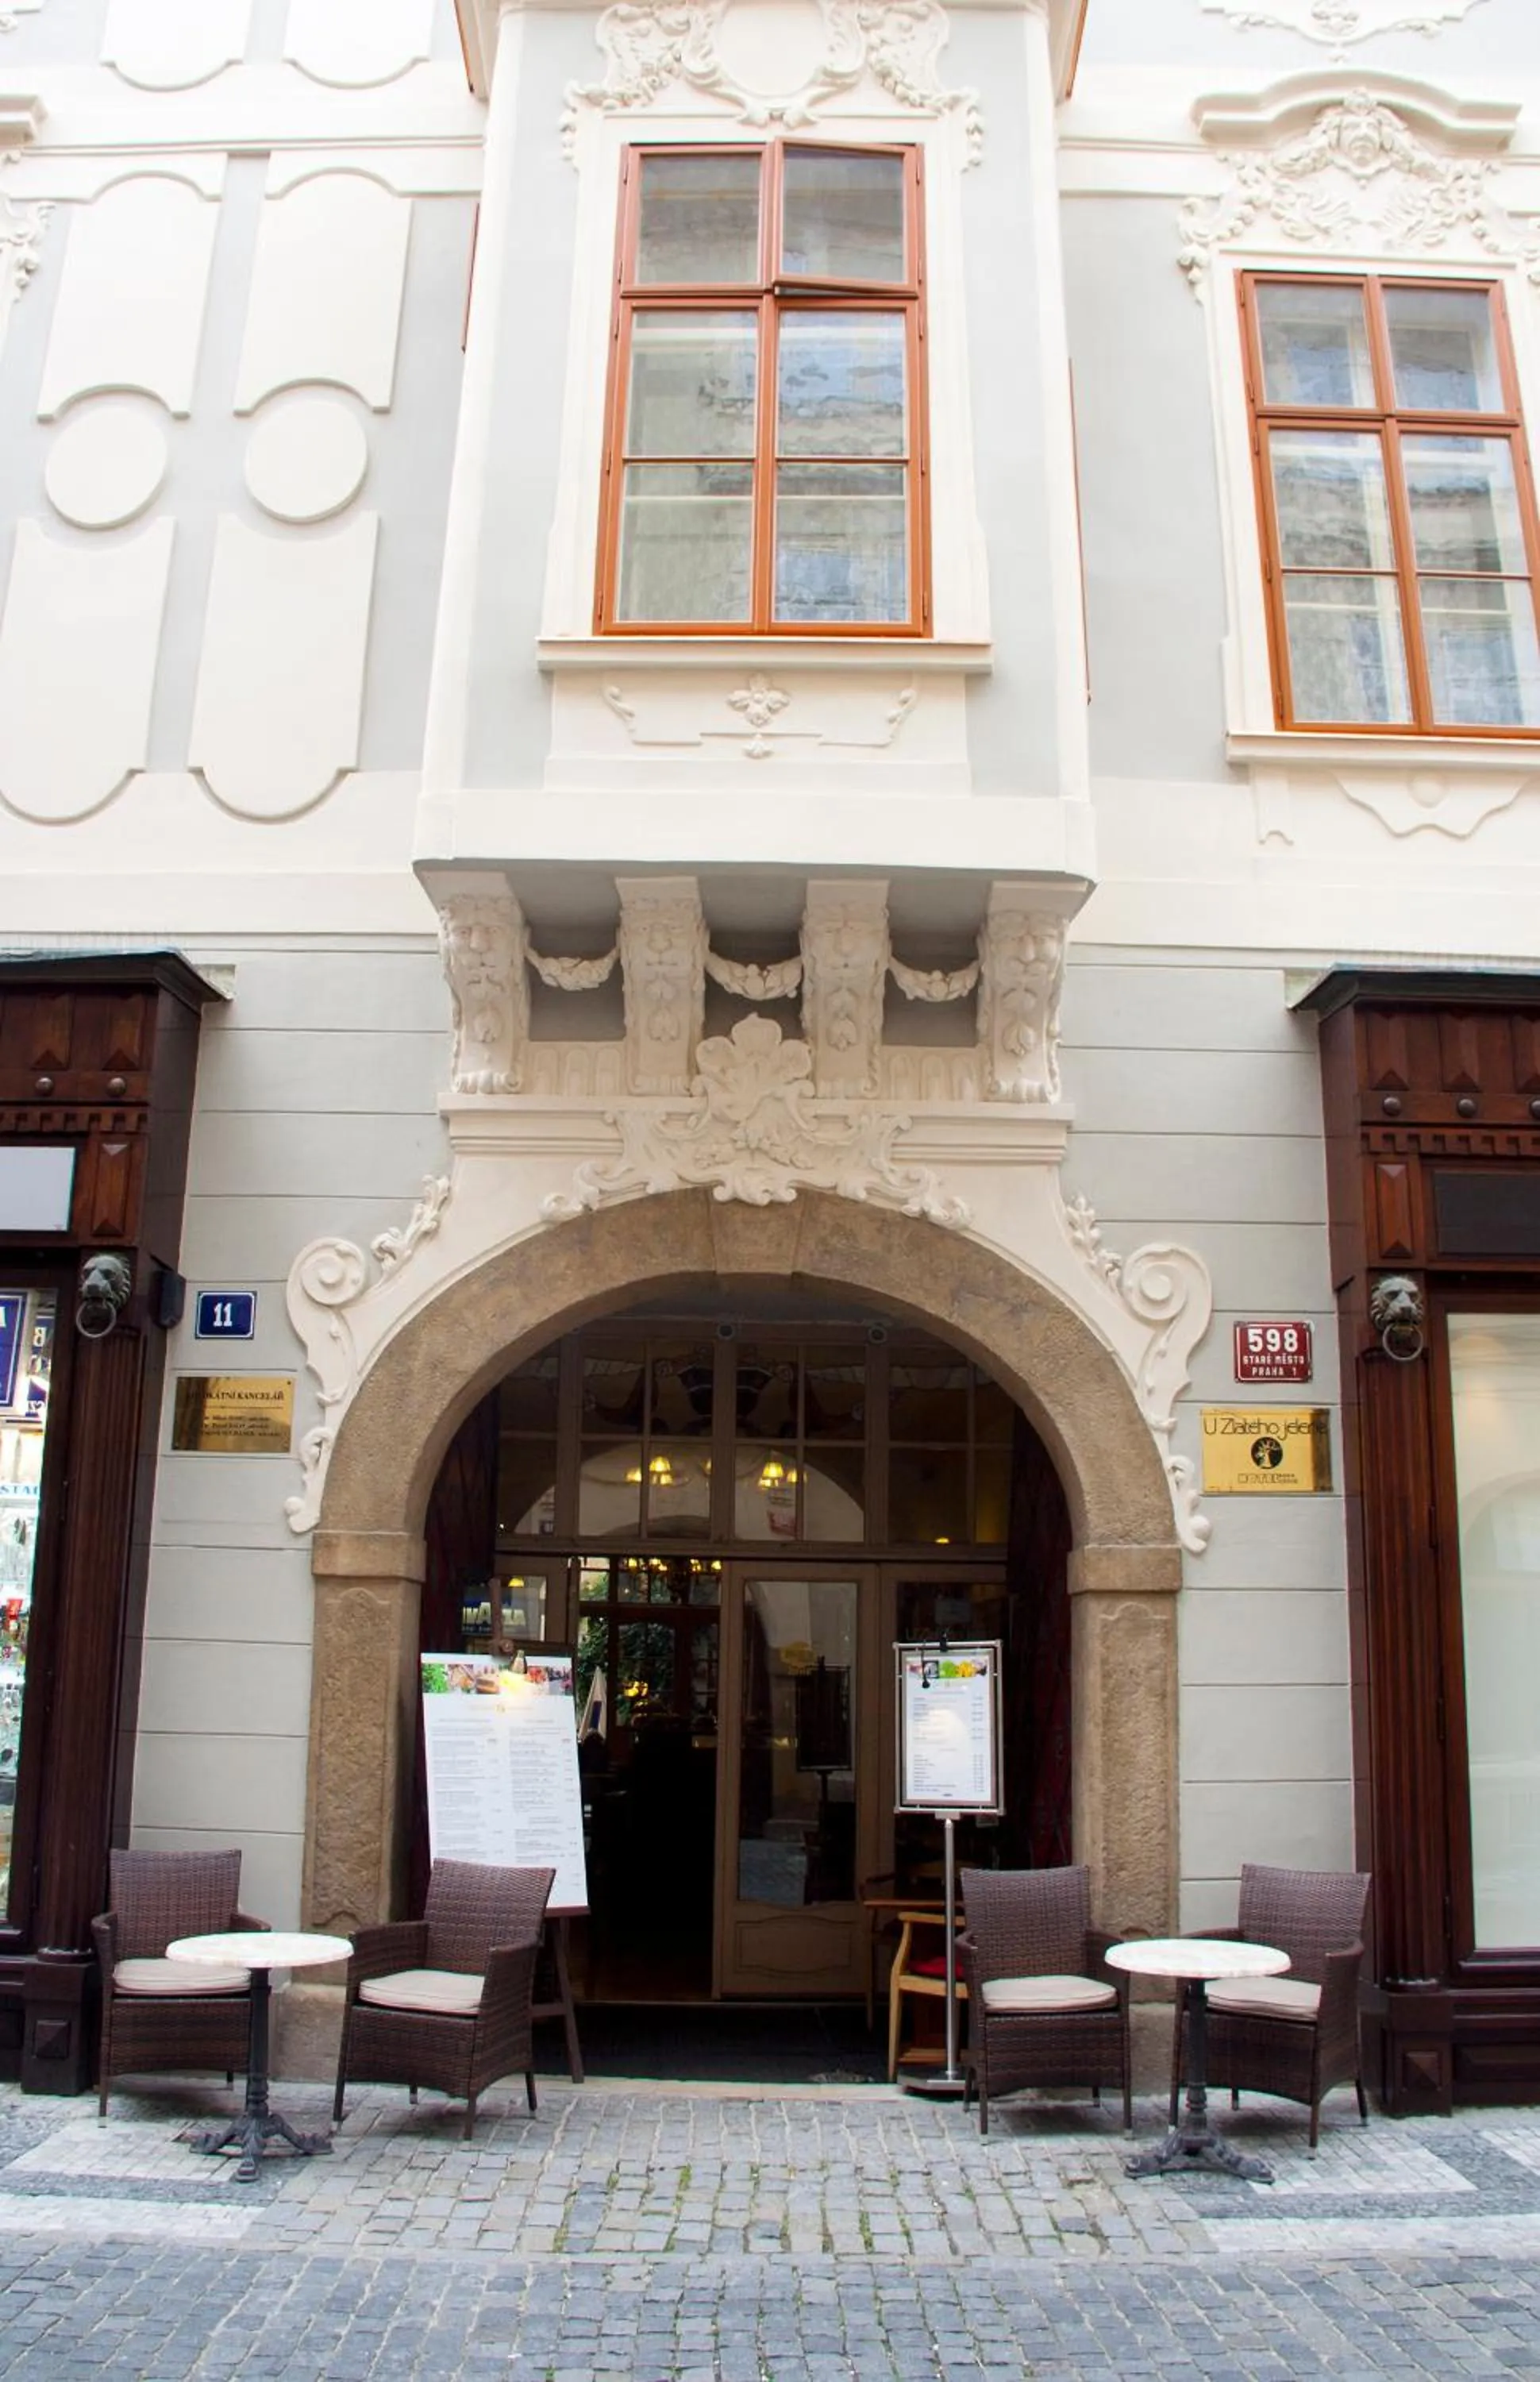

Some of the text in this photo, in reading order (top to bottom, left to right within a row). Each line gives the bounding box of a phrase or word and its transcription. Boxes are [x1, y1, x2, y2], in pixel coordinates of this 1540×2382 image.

[213, 1302, 233, 1327] 11
[1247, 1328, 1298, 1352] 598
[1242, 1353, 1272, 1365] STARÉ
[1252, 1366, 1296, 1376] PRAHA 1
[1203, 1417, 1217, 1436] U
